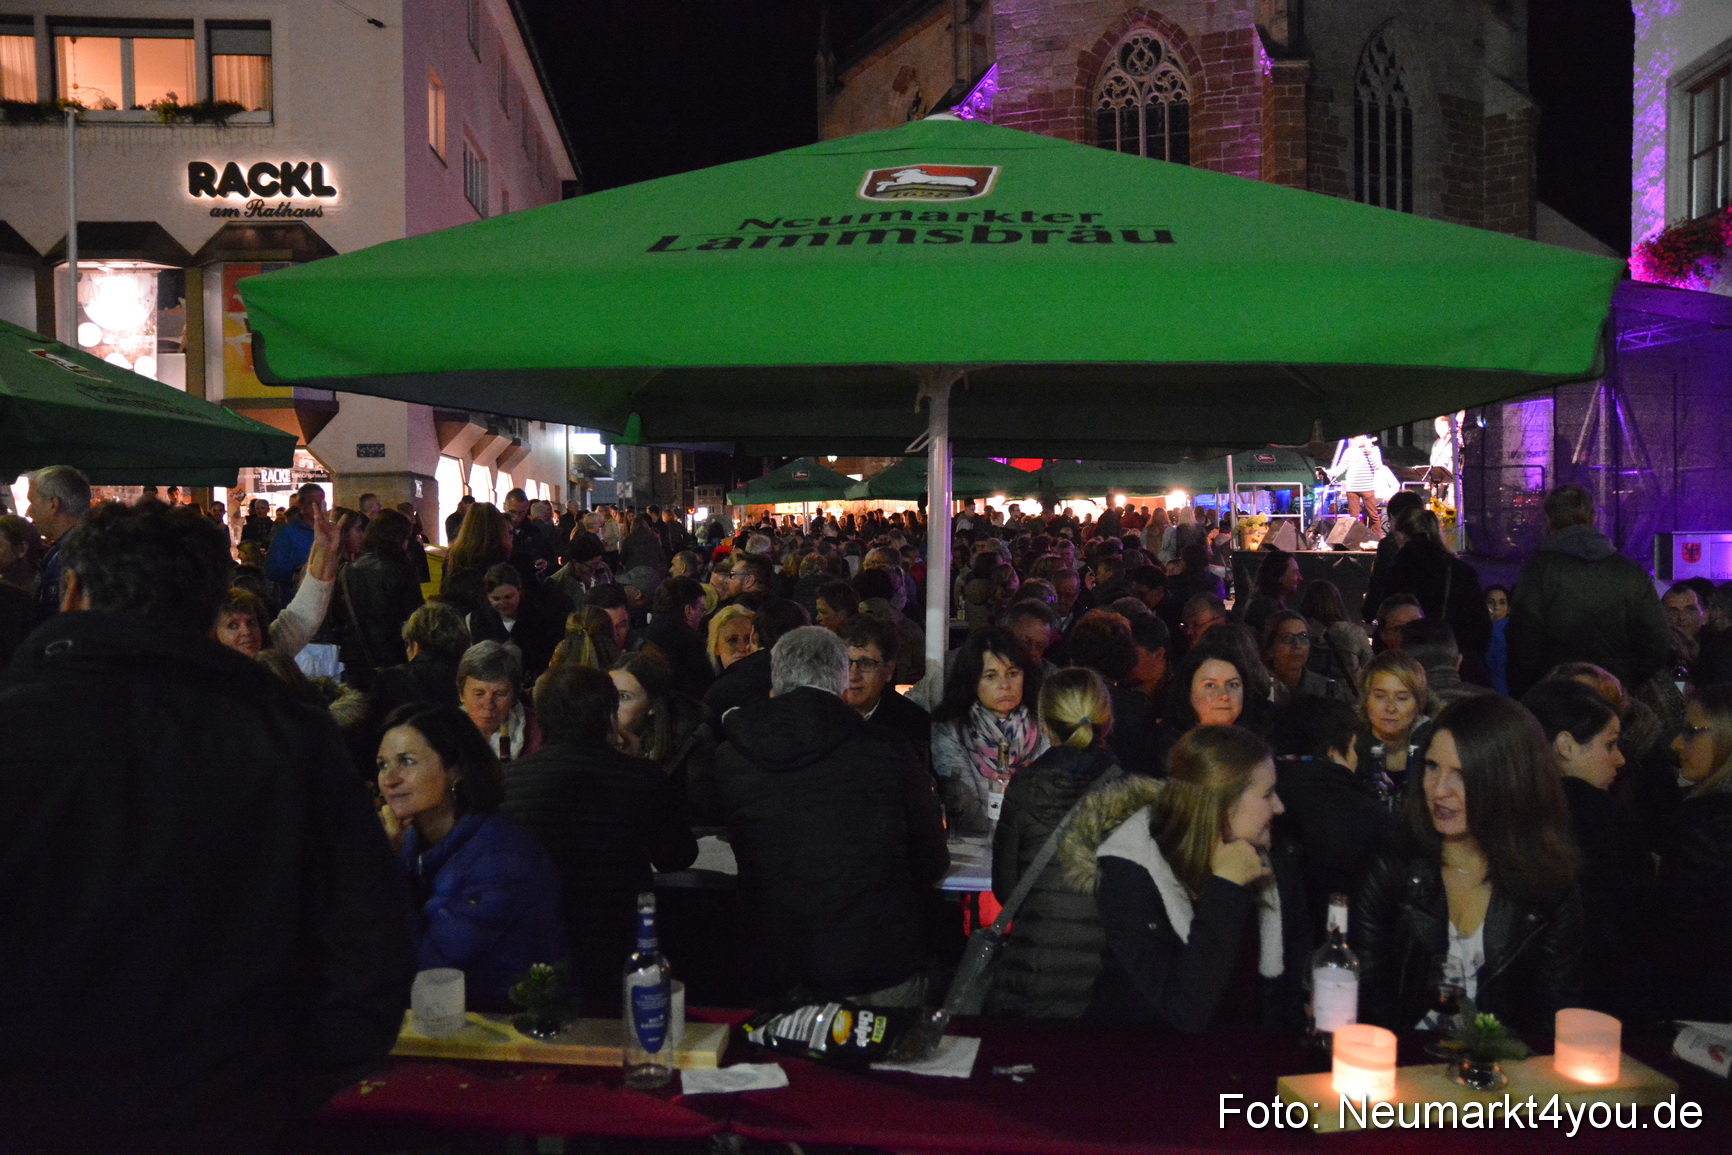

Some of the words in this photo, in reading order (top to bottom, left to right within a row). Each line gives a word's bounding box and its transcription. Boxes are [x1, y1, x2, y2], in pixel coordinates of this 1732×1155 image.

[188, 161, 337, 198] RACKL
[209, 206, 240, 218] am
[244, 198, 324, 218] Rathaus
[737, 209, 1103, 231] Neumarkter
[644, 223, 1177, 254] Lammsbräu
[260, 469, 291, 483] RACKL
